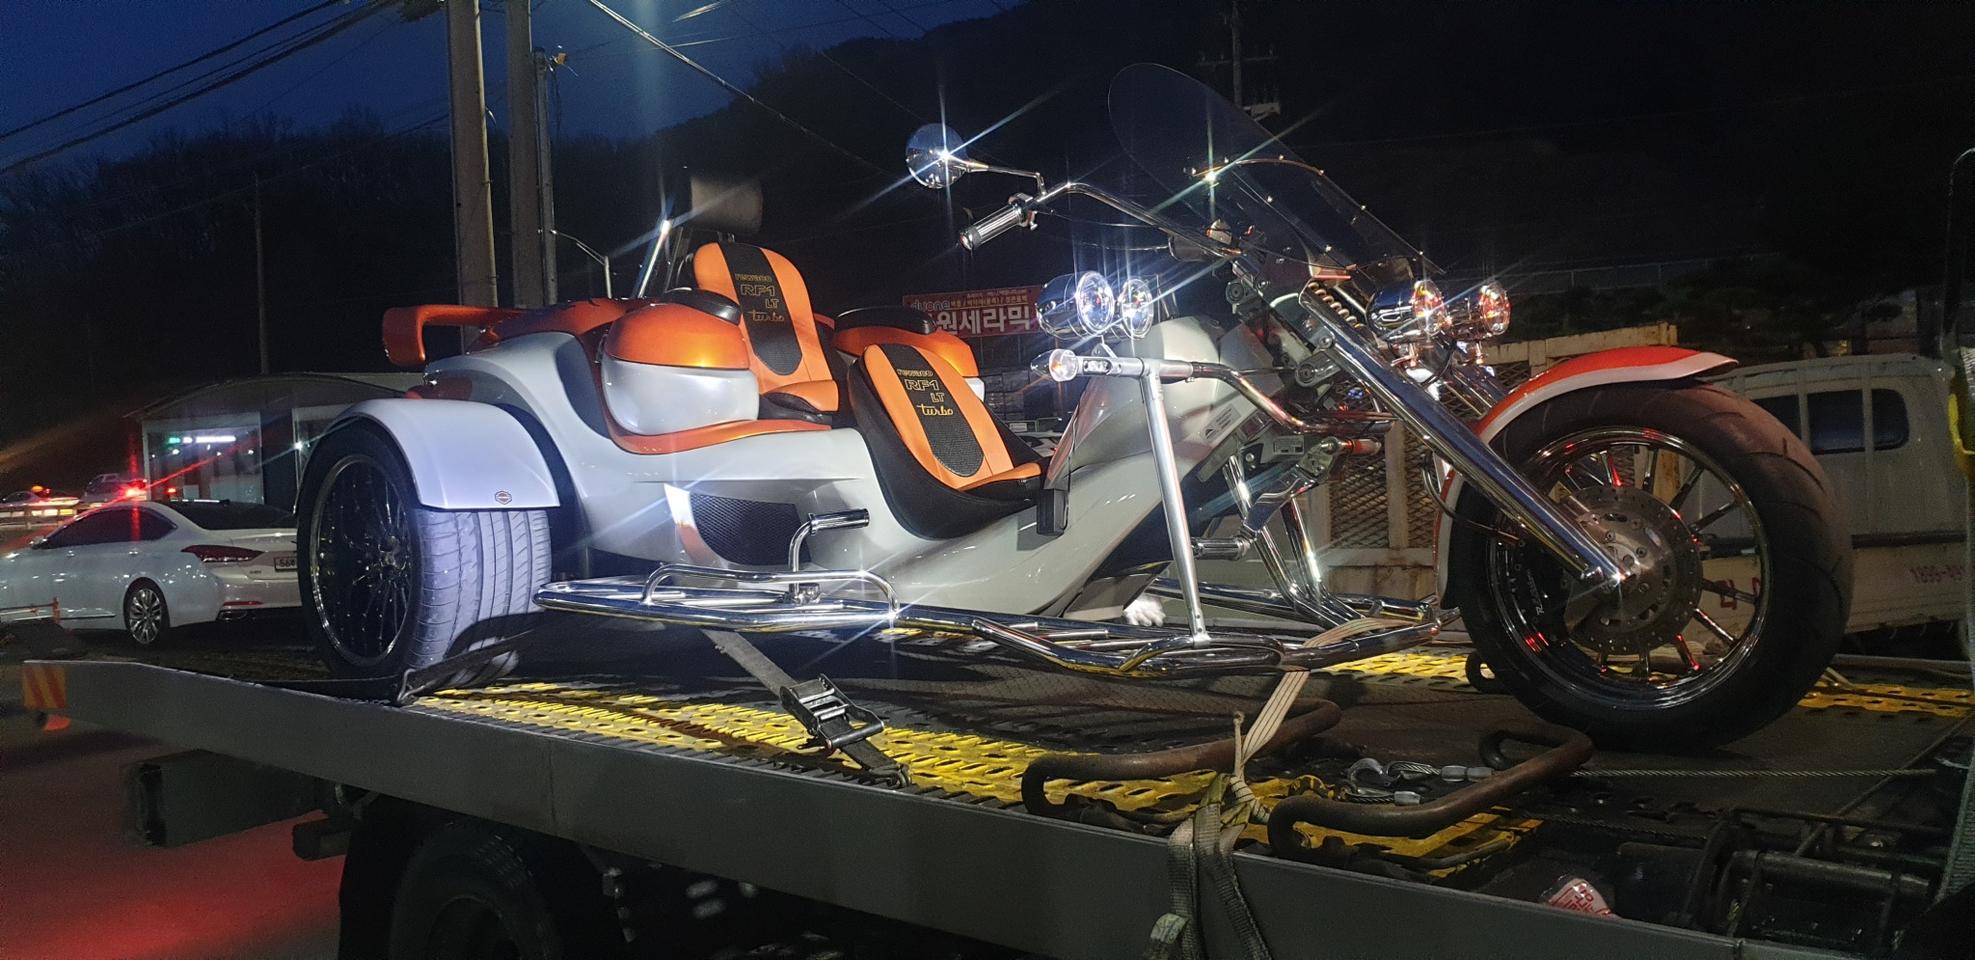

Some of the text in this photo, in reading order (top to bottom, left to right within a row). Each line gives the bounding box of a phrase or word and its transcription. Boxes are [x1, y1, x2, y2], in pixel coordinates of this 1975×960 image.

[740, 283, 776, 297] RF1
[765, 298, 780, 310] LT
[747, 309, 785, 322] turbo
[929, 305, 1031, 335] 원세라믹
[903, 378, 940, 391] RF1
[929, 392, 945, 403] LT
[916, 403, 954, 416] turbo
